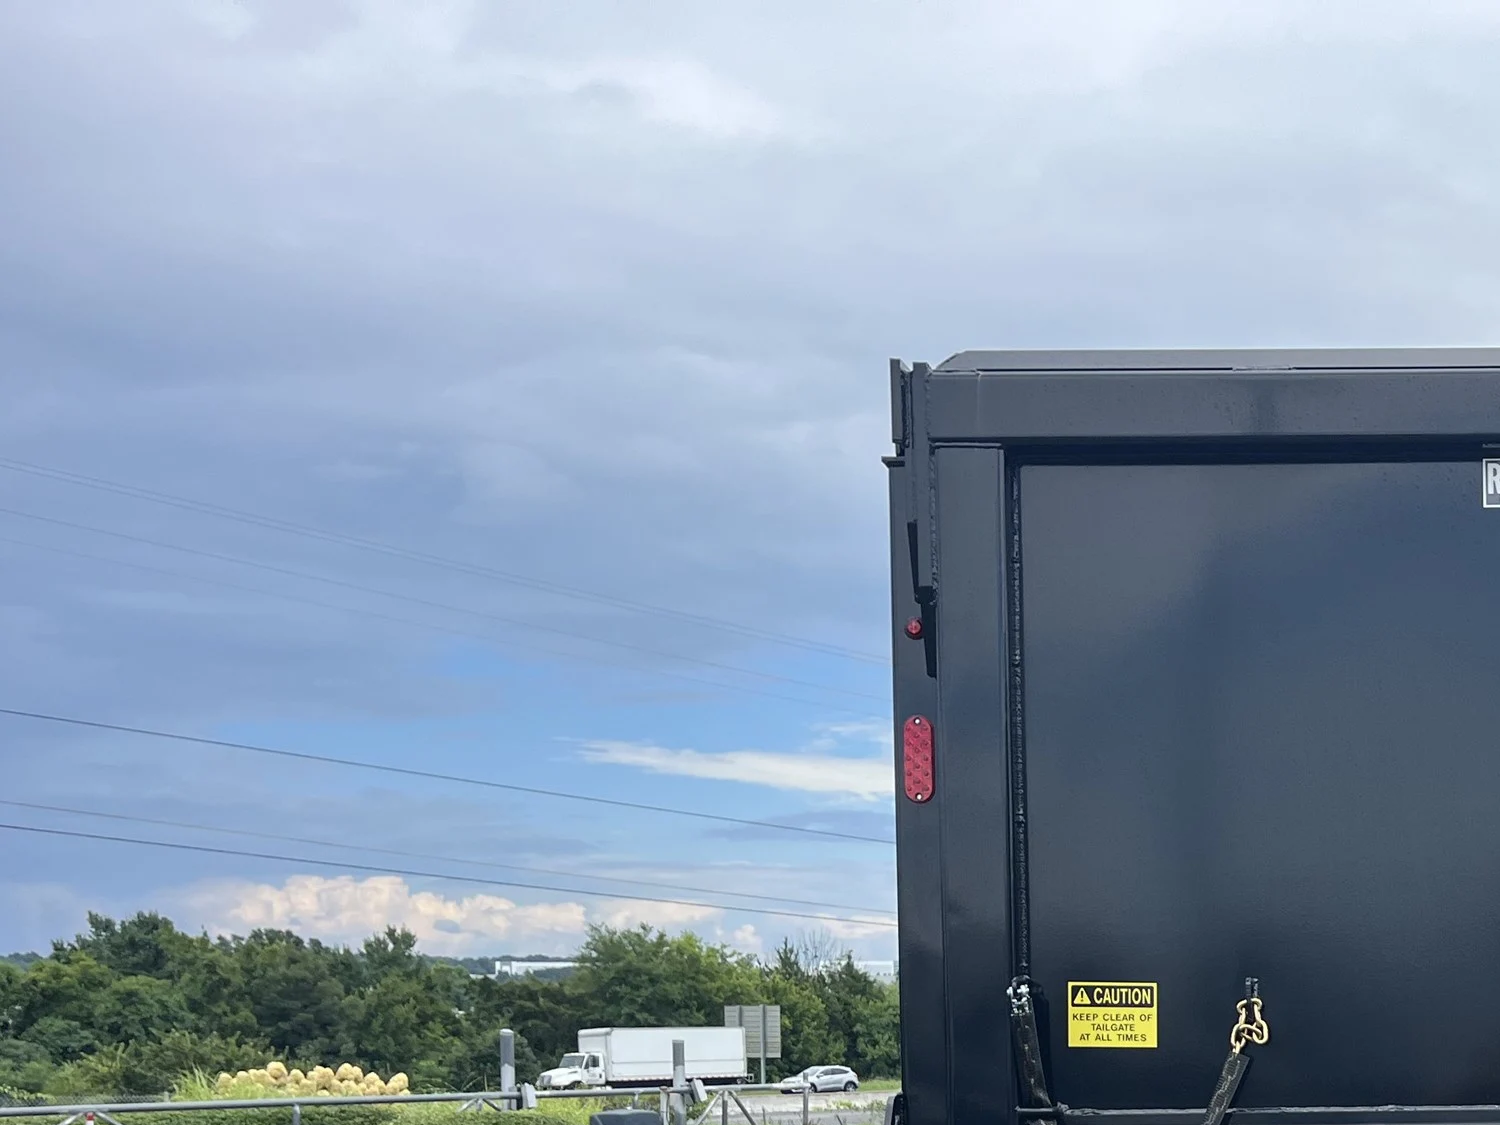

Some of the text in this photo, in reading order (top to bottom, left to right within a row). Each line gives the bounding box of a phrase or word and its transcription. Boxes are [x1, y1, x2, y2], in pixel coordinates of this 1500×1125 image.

[1093, 987, 1151, 1005] CAUTION
[1072, 1013, 1152, 1022] KEEP CLEAR OF
[1091, 1023, 1135, 1032] TAILGATE
[1079, 1033, 1147, 1042] AT ALL TIMES
